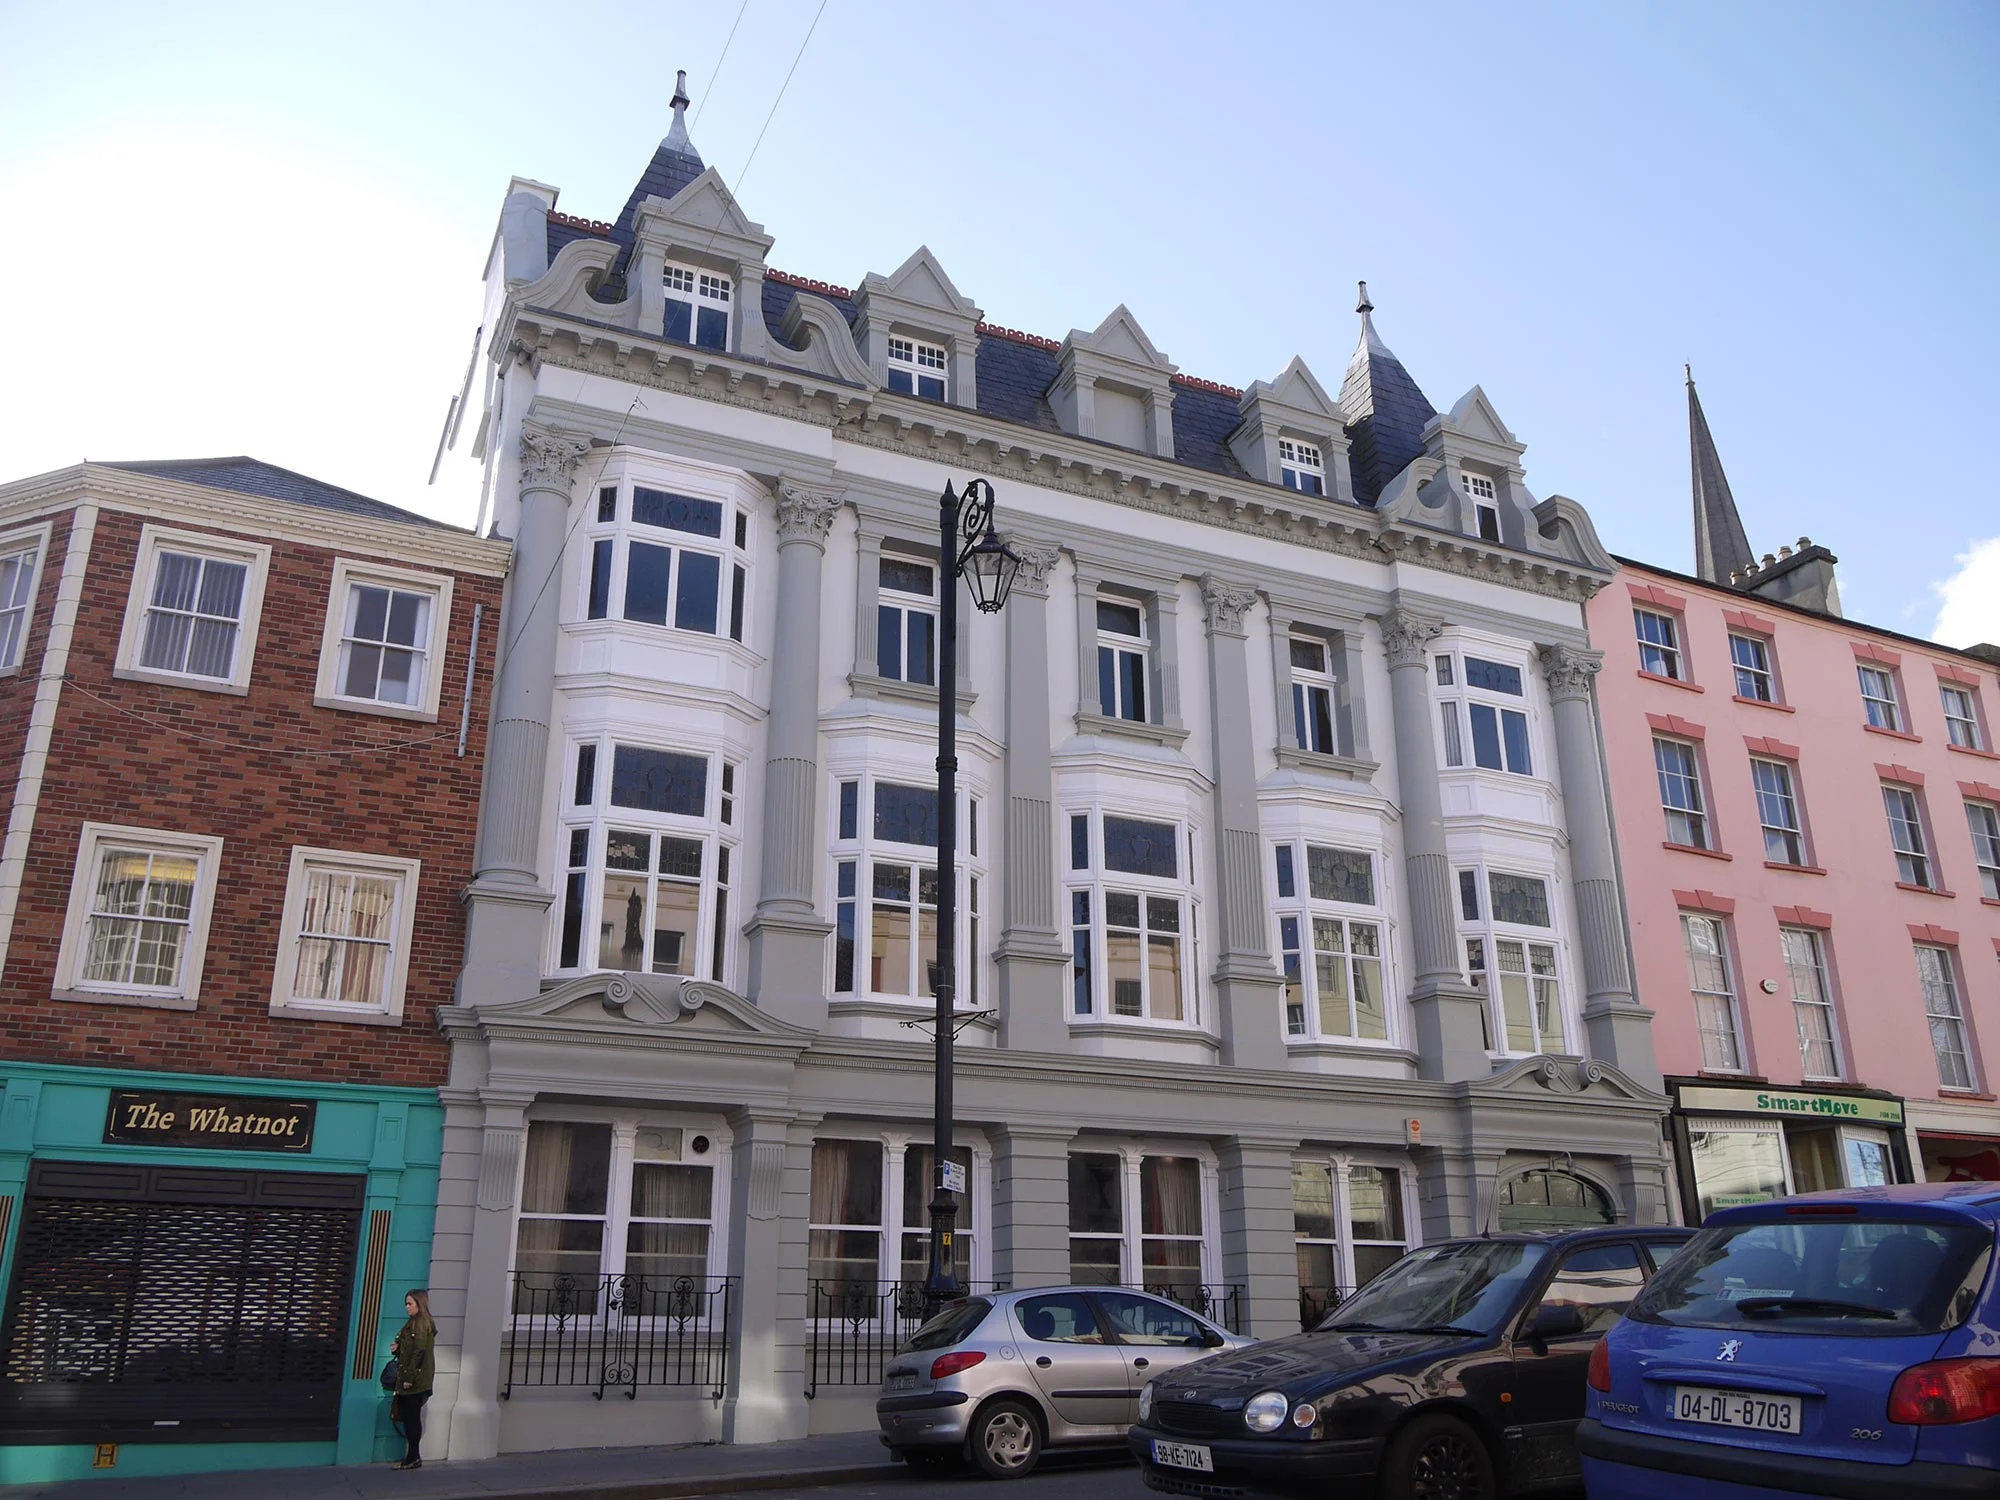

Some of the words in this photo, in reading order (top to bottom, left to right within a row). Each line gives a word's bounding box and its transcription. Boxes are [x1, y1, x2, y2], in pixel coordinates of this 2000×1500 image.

[1757, 1094, 1859, 1116] SmartMove
[125, 1103, 175, 1130] The
[189, 1106, 300, 1136] Whatnot
[1602, 1400, 1640, 1414] PEUGEOT
[1681, 1394, 1792, 1429] 04-DL-8703
[1850, 1428, 1883, 1440] 206
[1157, 1444, 1204, 1468] 98-KE-7124
